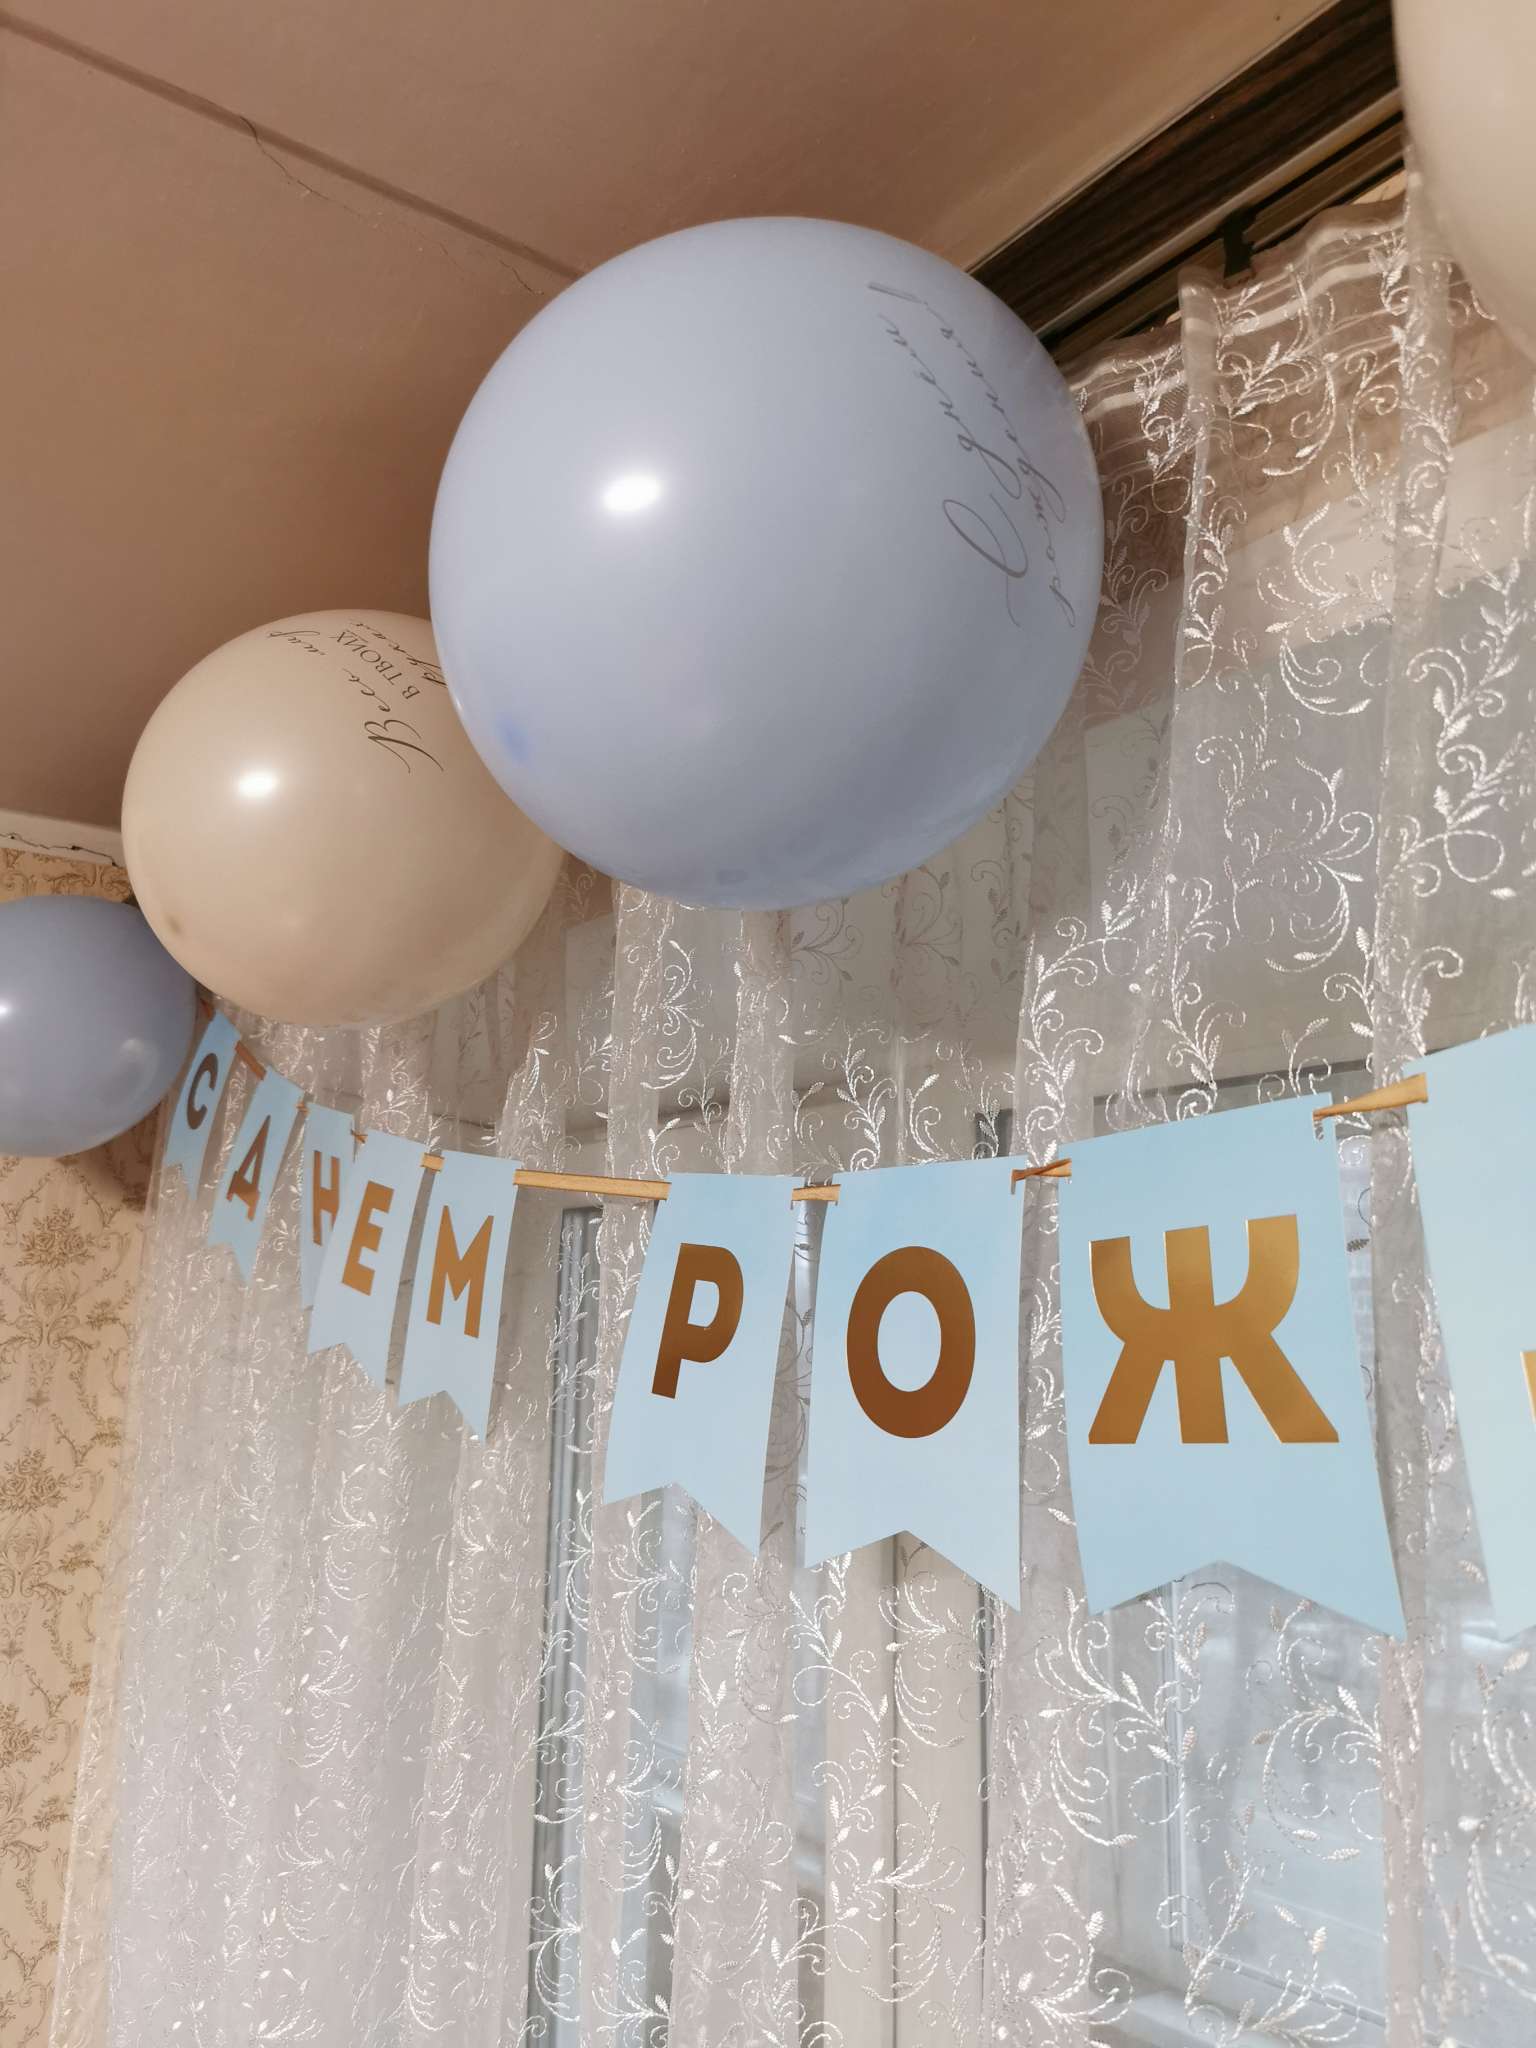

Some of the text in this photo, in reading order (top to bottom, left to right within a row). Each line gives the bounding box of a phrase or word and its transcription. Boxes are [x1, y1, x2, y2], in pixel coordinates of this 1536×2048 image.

[942, 493, 1029, 629] С
[342, 667, 444, 775] Весь
[186, 1053, 1536, 1444] С ДНЕМ РОЖ
